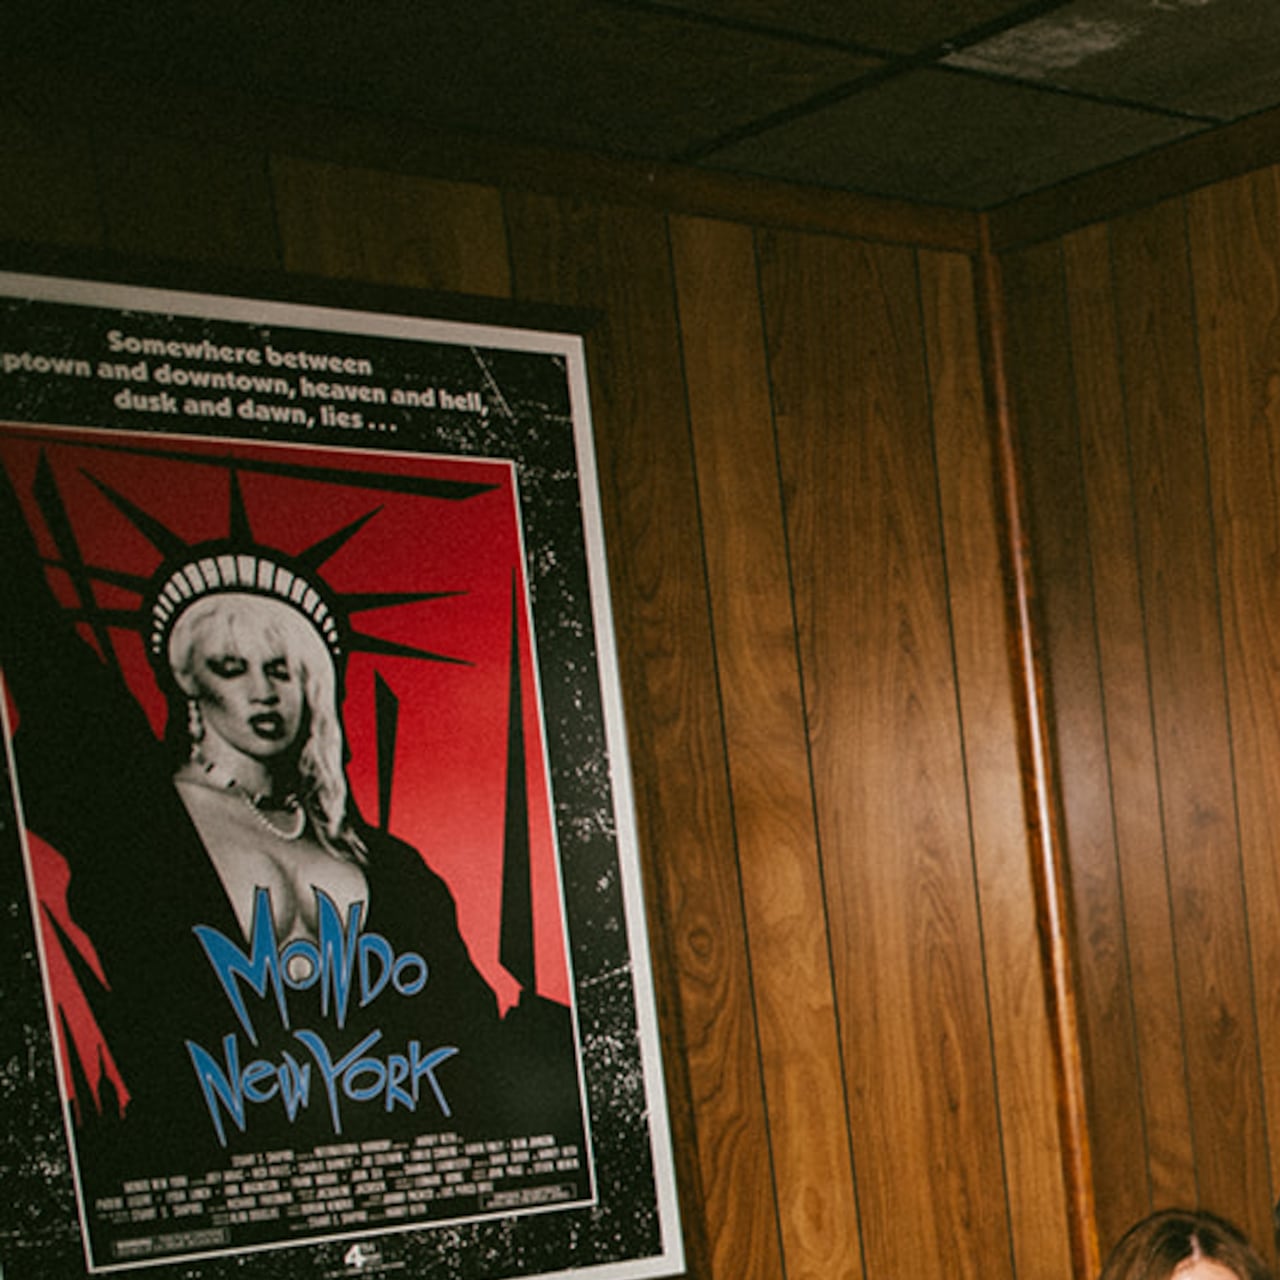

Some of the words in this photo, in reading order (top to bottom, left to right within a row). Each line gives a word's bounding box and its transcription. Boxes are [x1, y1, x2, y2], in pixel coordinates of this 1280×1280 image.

[107, 328, 262, 366] Somewhere
[265, 345, 373, 376] between
[0, 351, 91, 378] ptown
[97, 360, 149, 382] and
[153, 363, 296, 400] downtown,
[299, 375, 387, 404] heaven
[391, 386, 436, 408] and
[438, 388, 489, 417] hell,
[113, 387, 178, 415] dusk
[183, 396, 232, 418] and
[236, 400, 315, 429] dawn,
